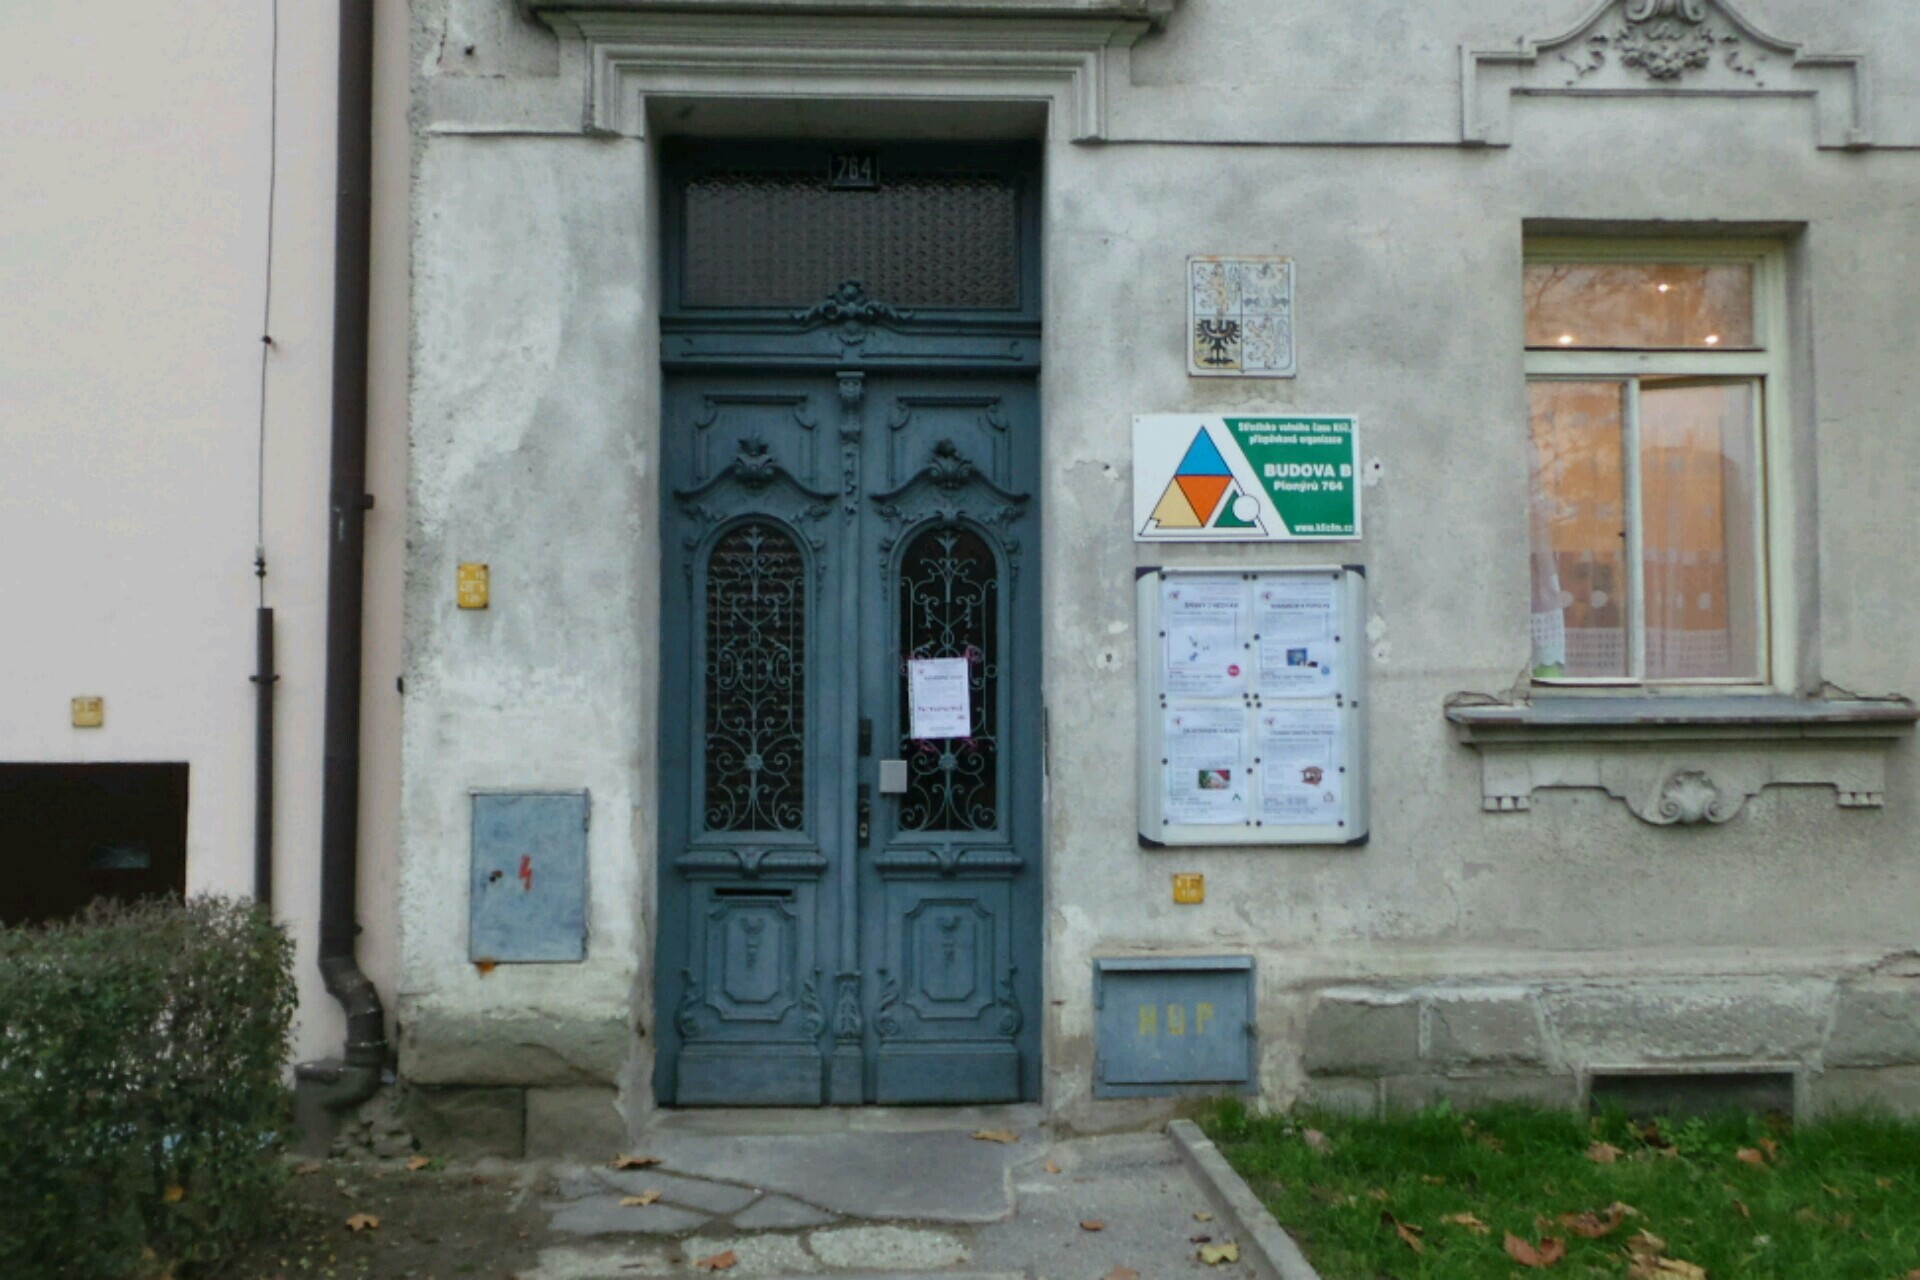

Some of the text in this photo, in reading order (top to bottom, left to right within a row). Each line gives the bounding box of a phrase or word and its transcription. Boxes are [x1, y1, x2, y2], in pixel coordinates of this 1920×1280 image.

[1264, 464, 1352, 478] BUDOVA B
[1273, 480, 1344, 493] Pionýrů 764
